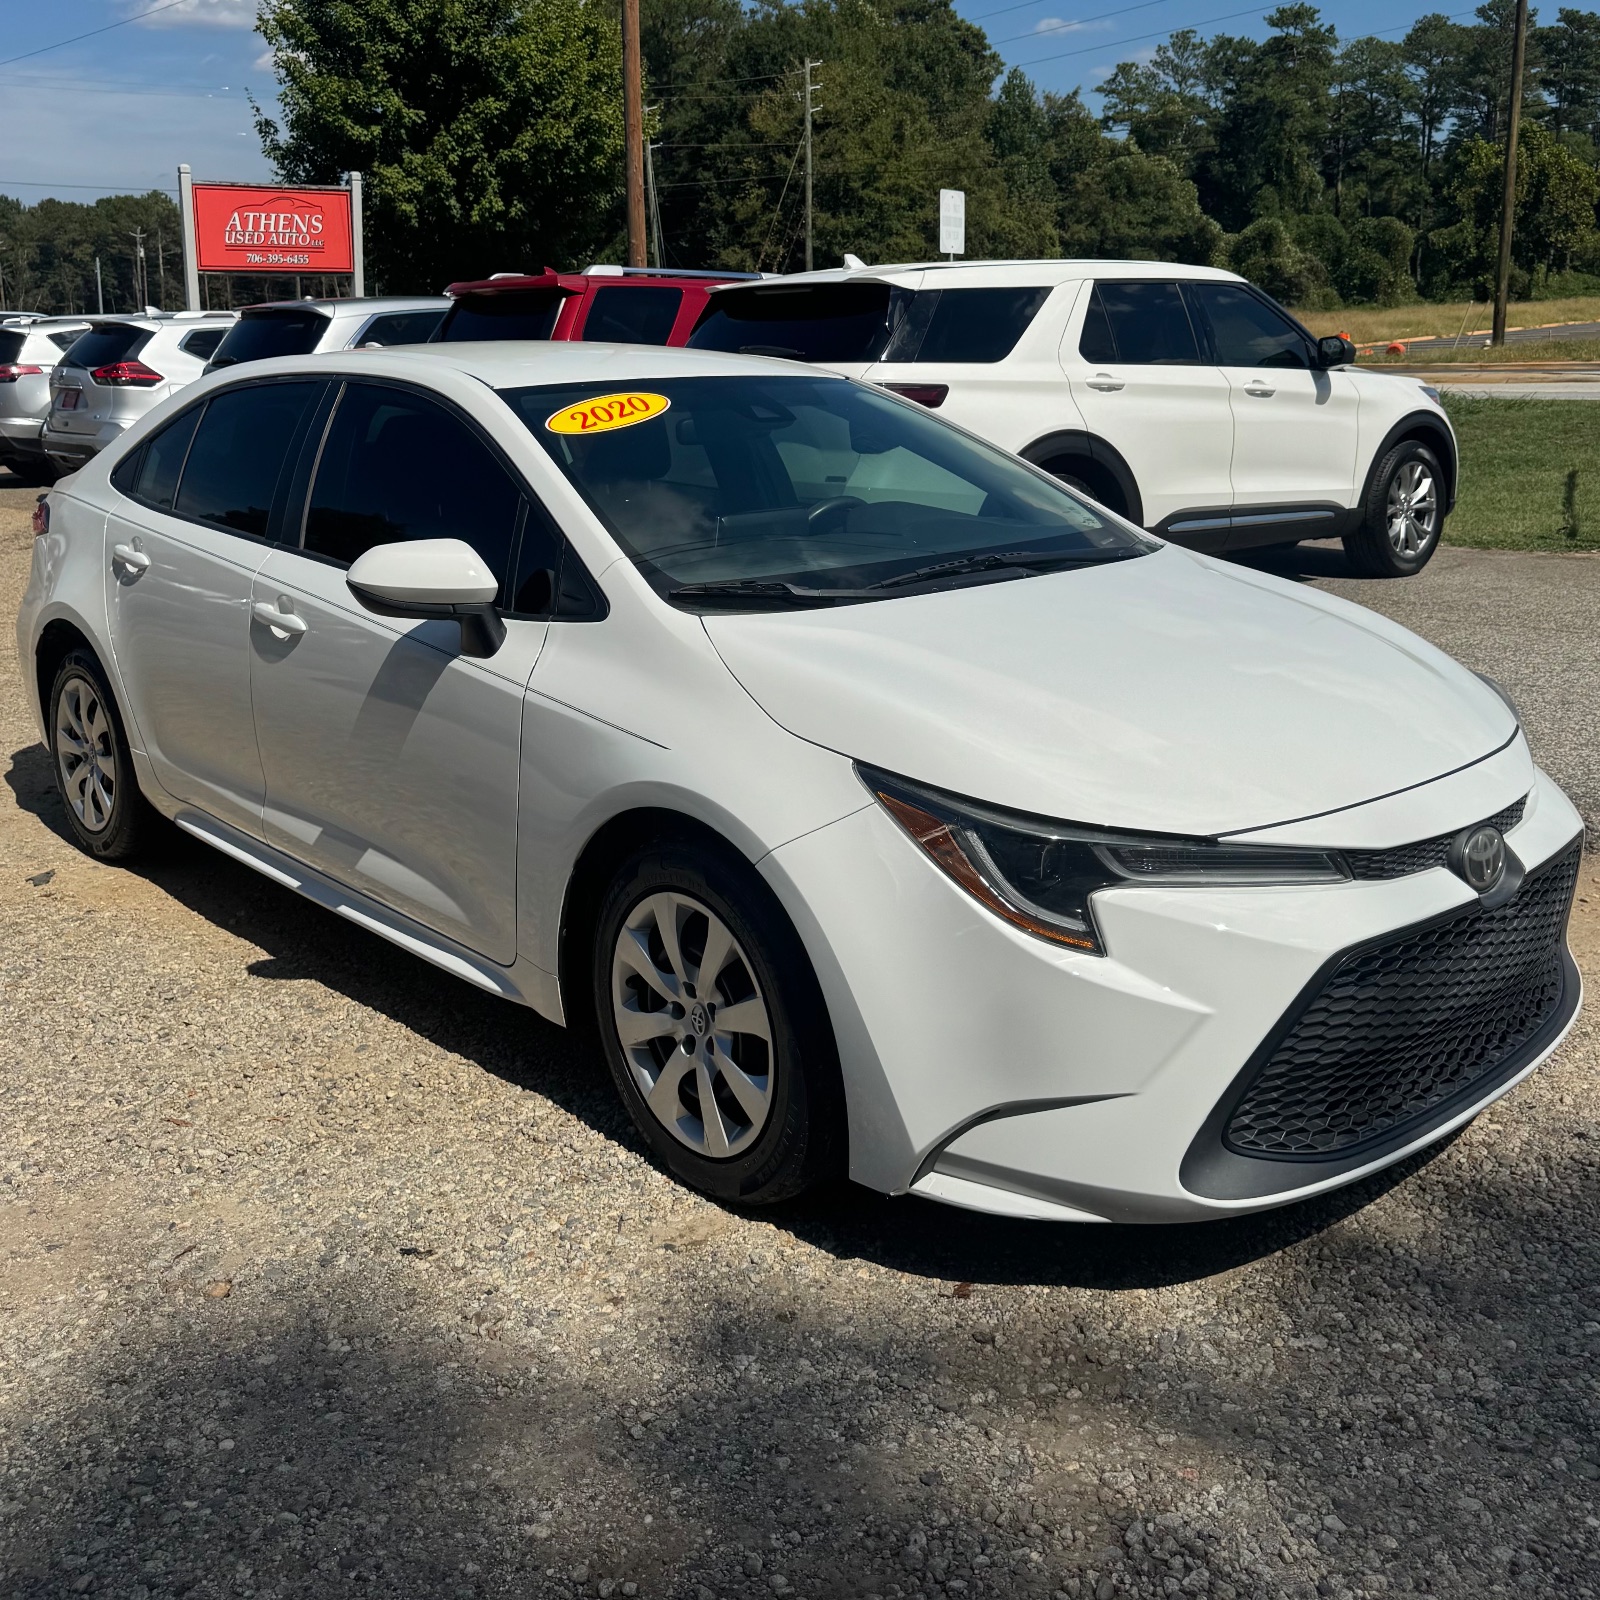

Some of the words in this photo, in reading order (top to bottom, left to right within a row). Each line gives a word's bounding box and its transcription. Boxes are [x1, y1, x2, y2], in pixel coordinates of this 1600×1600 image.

[225, 212, 323, 234] ATHENS
[225, 232, 265, 245] USED
[268, 233, 310, 246] AUTO
[246, 253, 309, 265] 706-395-6455
[570, 396, 650, 430] 2020
